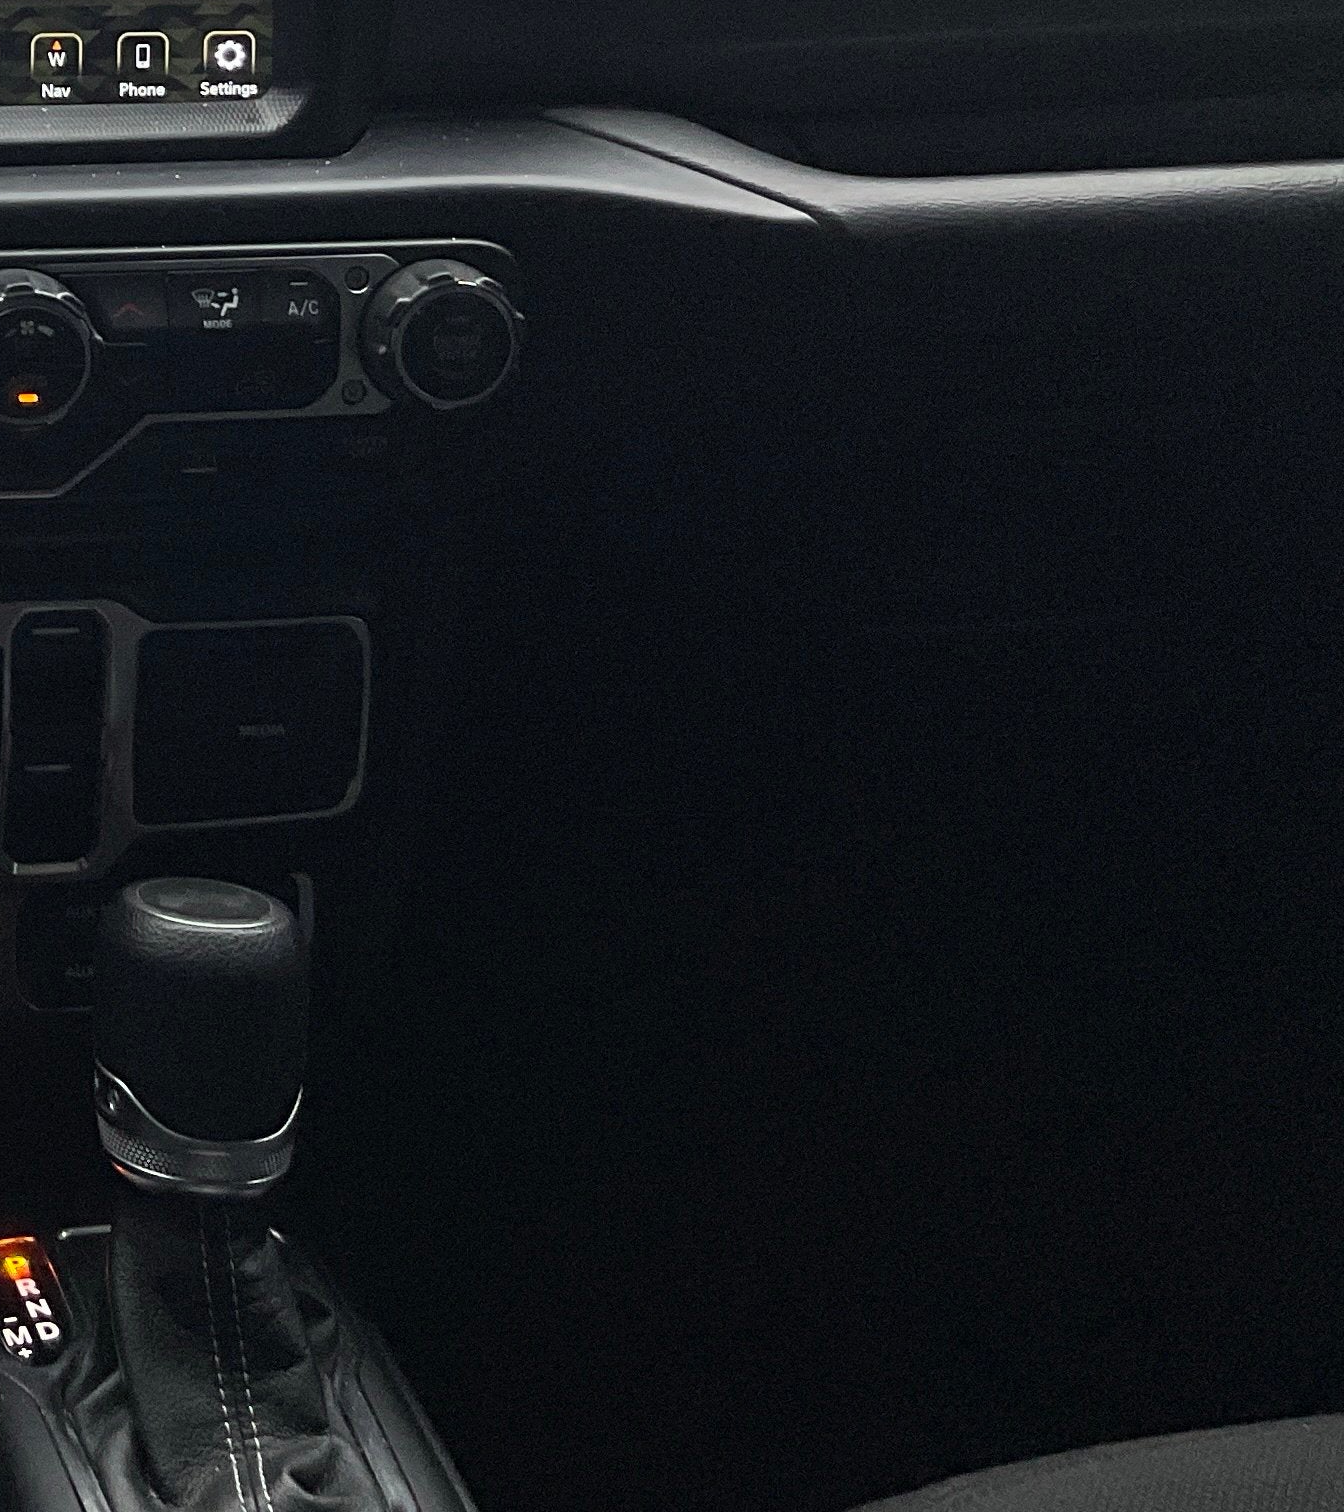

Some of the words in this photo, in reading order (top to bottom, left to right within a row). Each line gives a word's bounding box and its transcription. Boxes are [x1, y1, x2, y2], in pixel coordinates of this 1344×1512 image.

[48, 51, 66, 67] W
[41, 84, 71, 99] Nav
[119, 82, 165, 98] Phone
[200, 81, 258, 100] Settings
[288, 298, 319, 317] A/C
[4, 1255, 27, 1279] P
[15, 1277, 41, 1296] R
[25, 1298, 52, 1318] N
[2, 1325, 33, 1347] M
[34, 1321, 60, 1341] D
